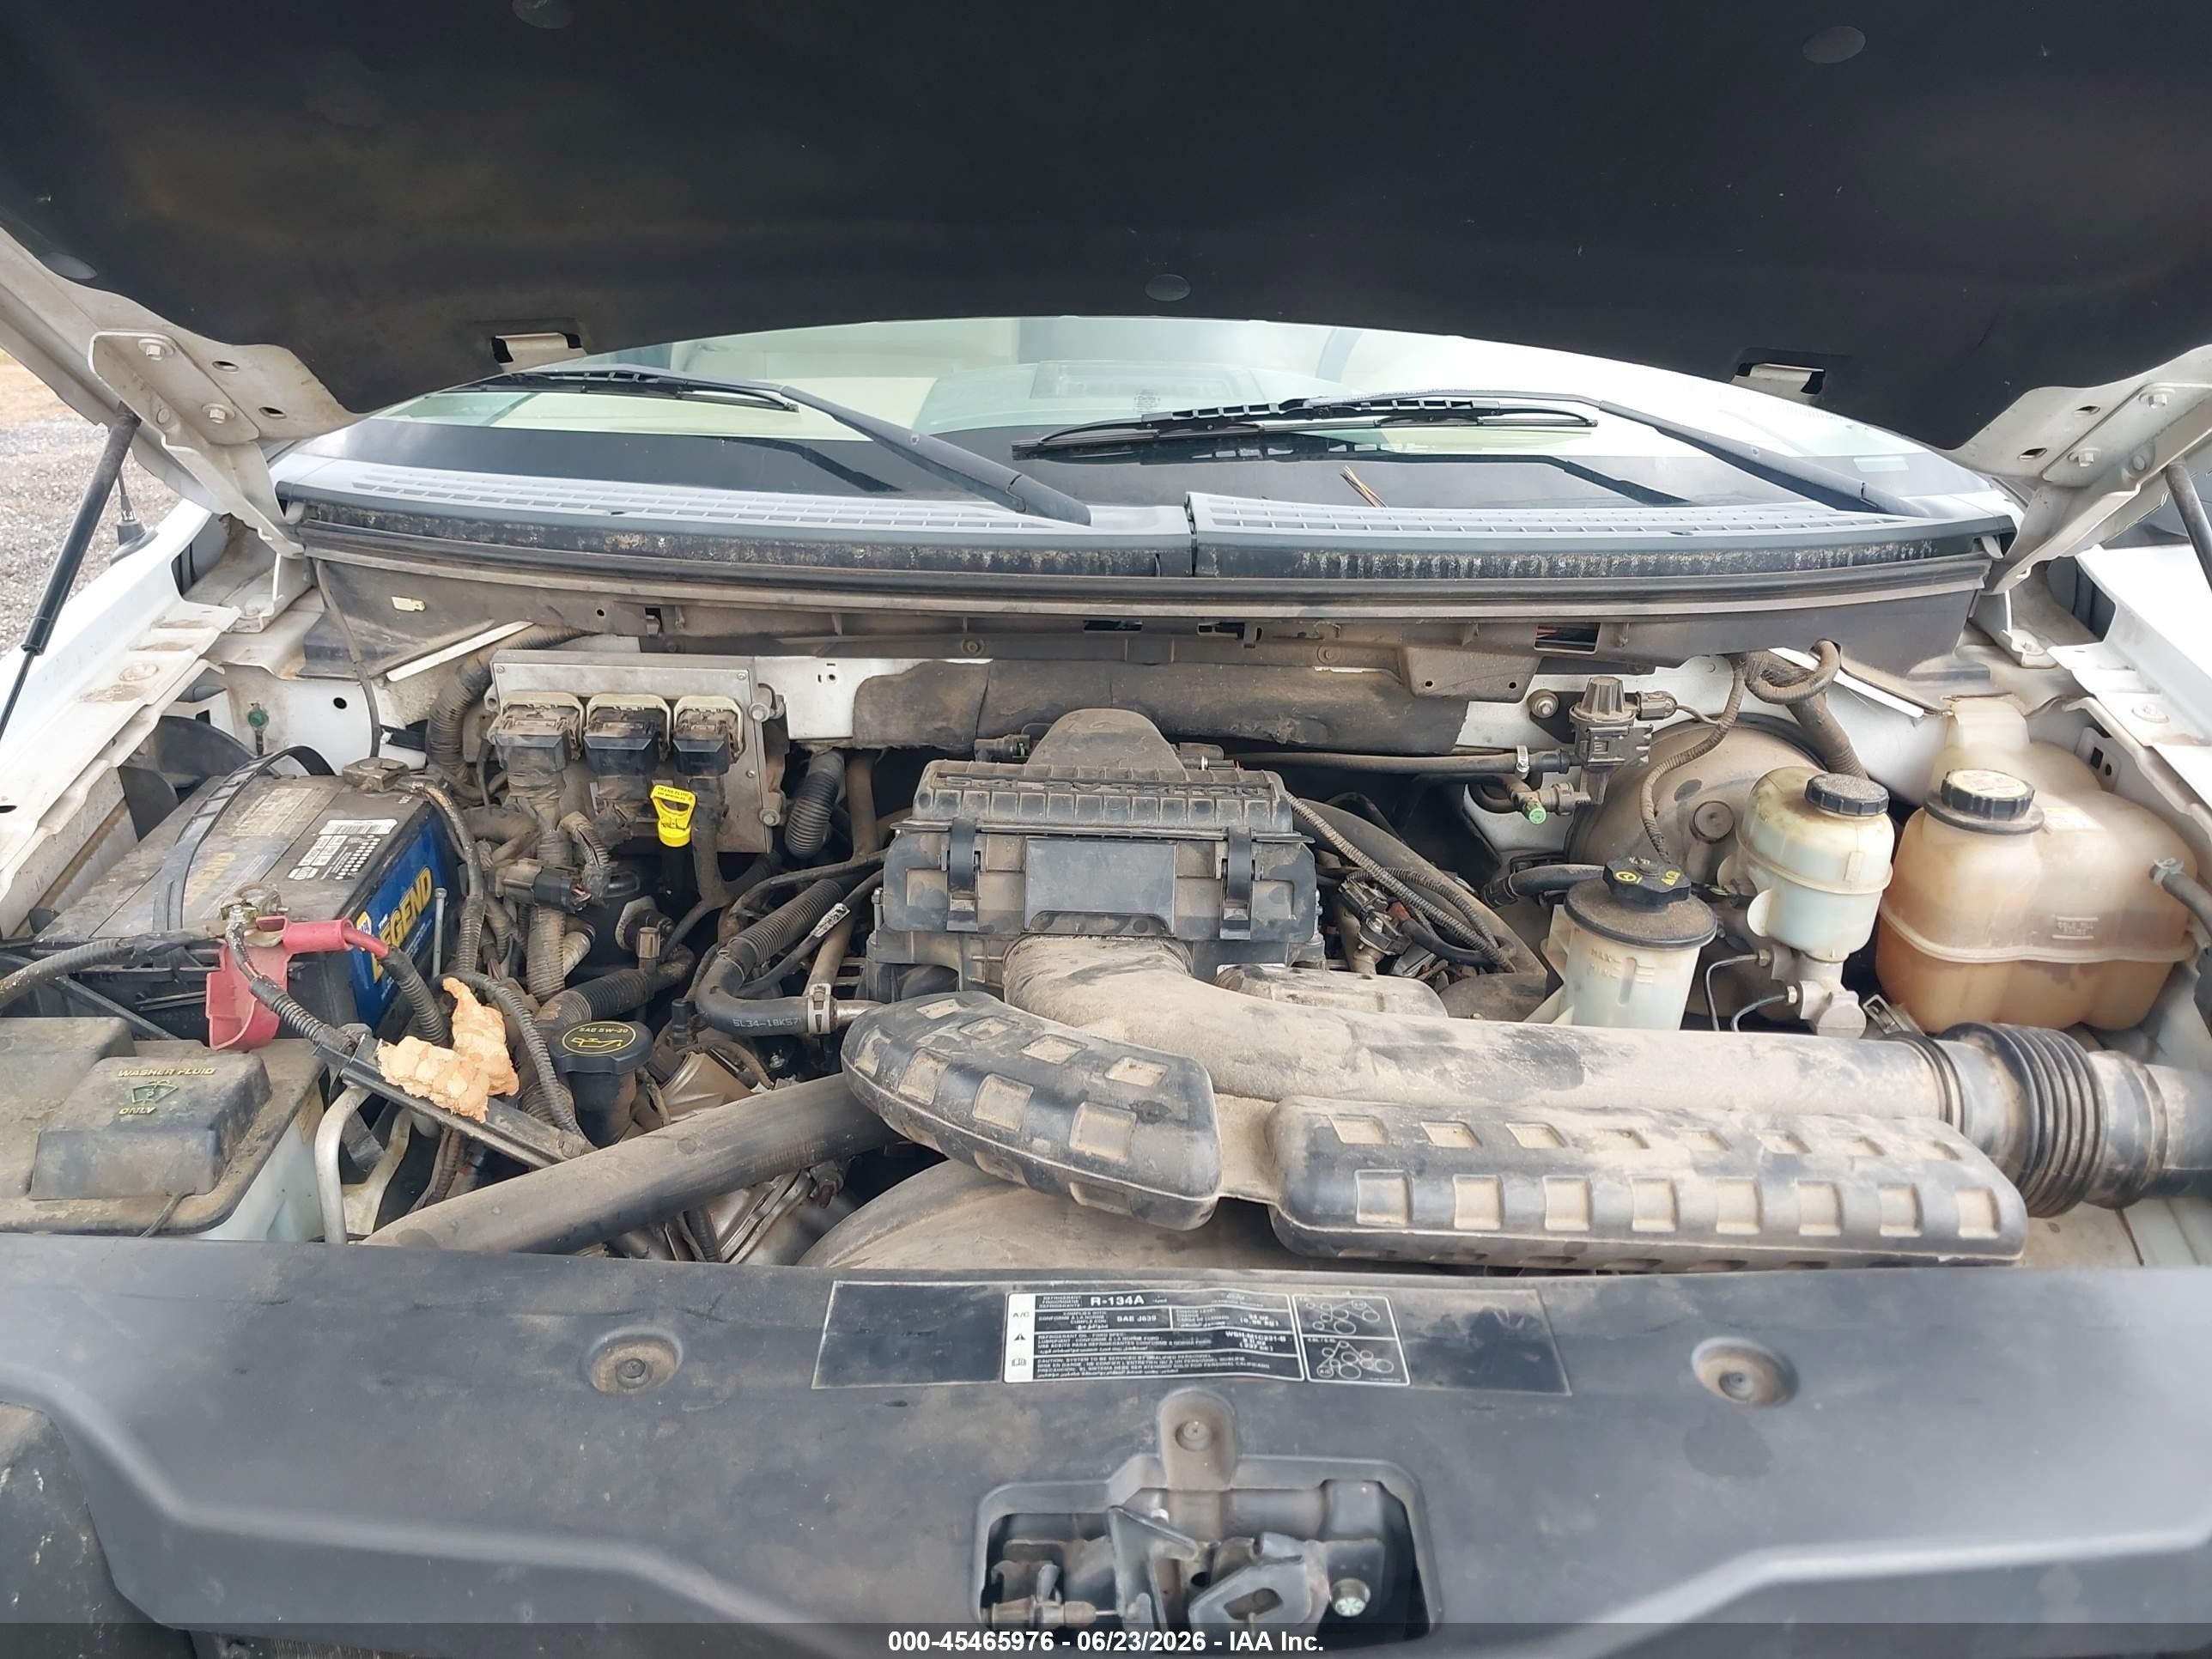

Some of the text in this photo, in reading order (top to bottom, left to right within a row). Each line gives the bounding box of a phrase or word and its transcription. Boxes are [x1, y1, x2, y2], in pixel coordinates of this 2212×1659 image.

[118, 1067, 216, 1078] WASHER FLUID
[118, 1106, 157, 1115] ONLY
[1090, 1294, 1145, 1307] R-134A
